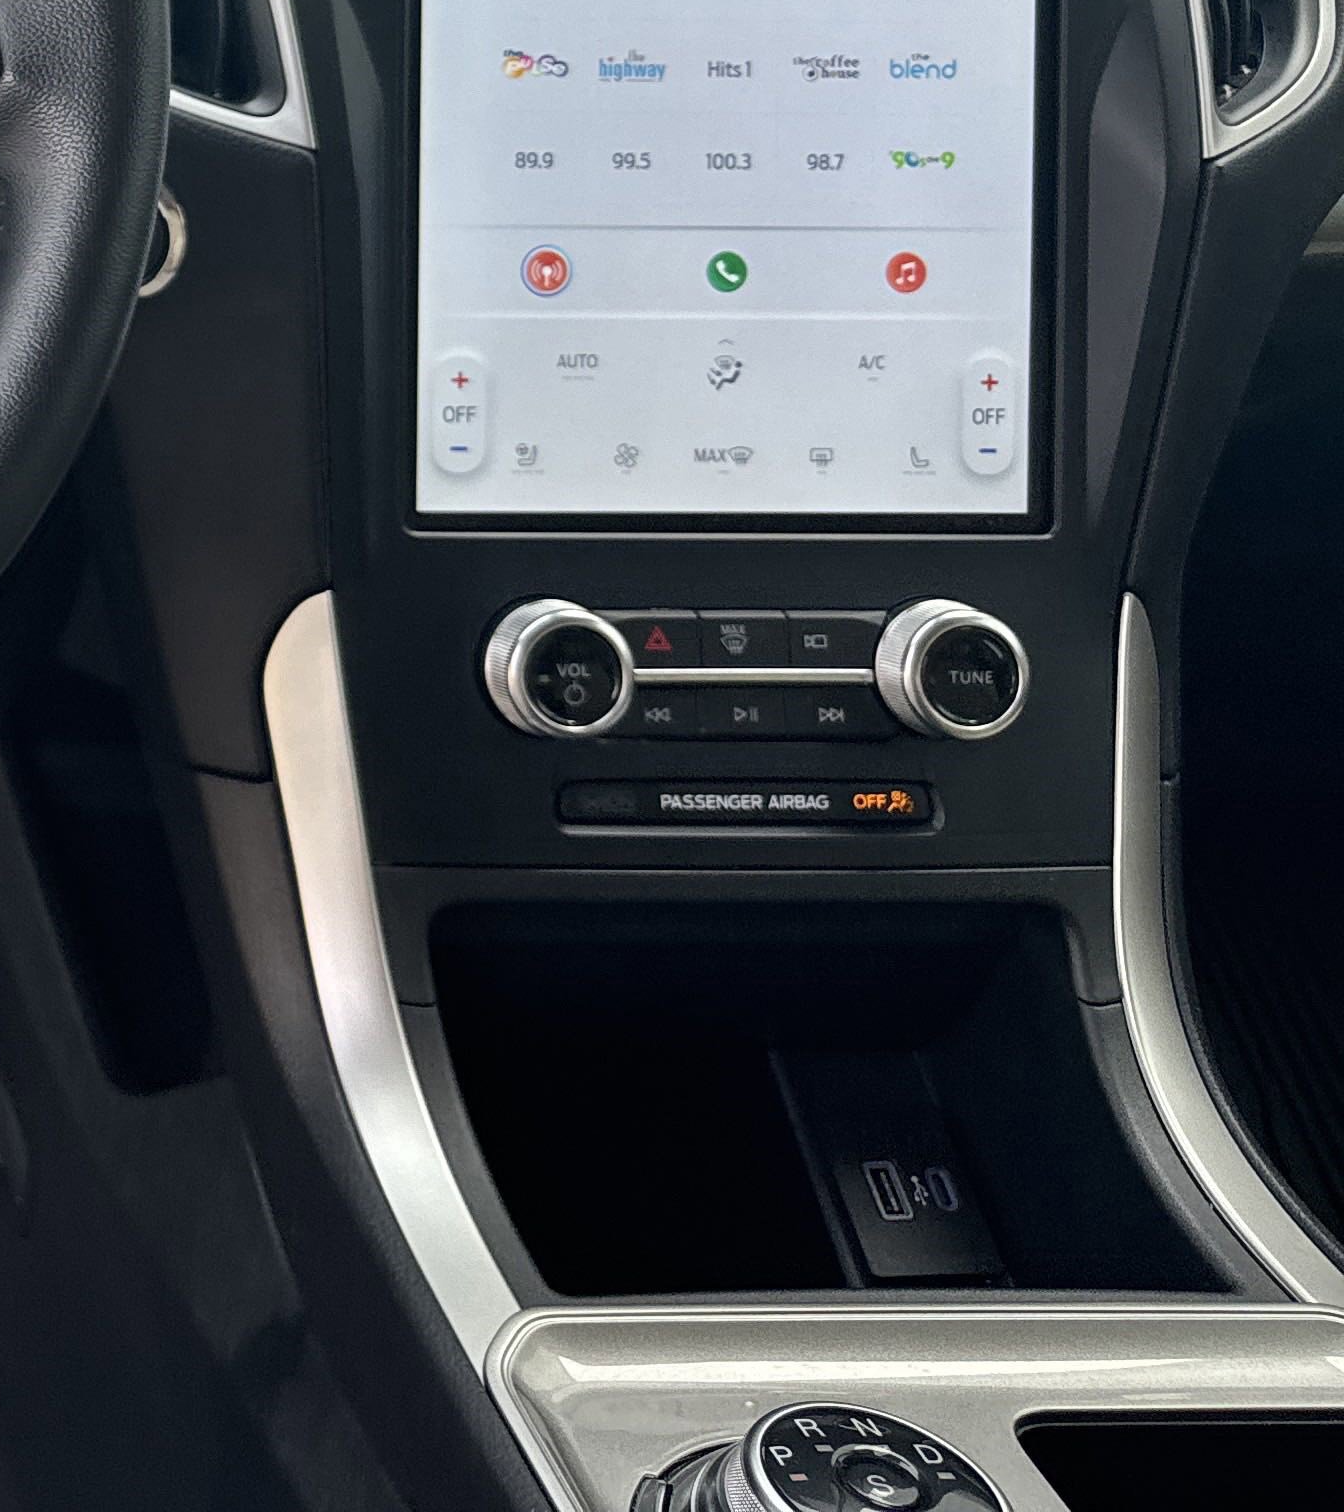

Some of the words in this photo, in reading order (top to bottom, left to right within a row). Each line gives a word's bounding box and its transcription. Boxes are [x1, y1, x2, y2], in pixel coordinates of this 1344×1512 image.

[598, 58, 666, 82] highway
[707, 61, 742, 78] Hits
[745, 61, 752, 78] 1
[815, 54, 860, 68] coffee
[889, 59, 957, 79] blend
[821, 67, 860, 79] house
[514, 152, 554, 170] 89.9
[612, 152, 651, 170] 99.5
[704, 152, 751, 171] 100.3
[806, 153, 845, 171] 98.7
[556, 353, 599, 369] AUTO
[857, 354, 886, 371] A/C
[442, 406, 477, 423] OFF
[971, 407, 1006, 425] OFF
[694, 447, 726, 463] MAX
[556, 662, 592, 678] VOL
[949, 669, 994, 685] TUNE
[660, 793, 763, 812] PASSENGER
[768, 793, 830, 812] AIRBAG
[853, 793, 888, 811] OFF
[794, 1418, 826, 1438] R
[850, 1417, 883, 1438] N
[767, 1446, 795, 1467] P
[914, 1444, 944, 1465] D
[865, 1475, 894, 1499] S
